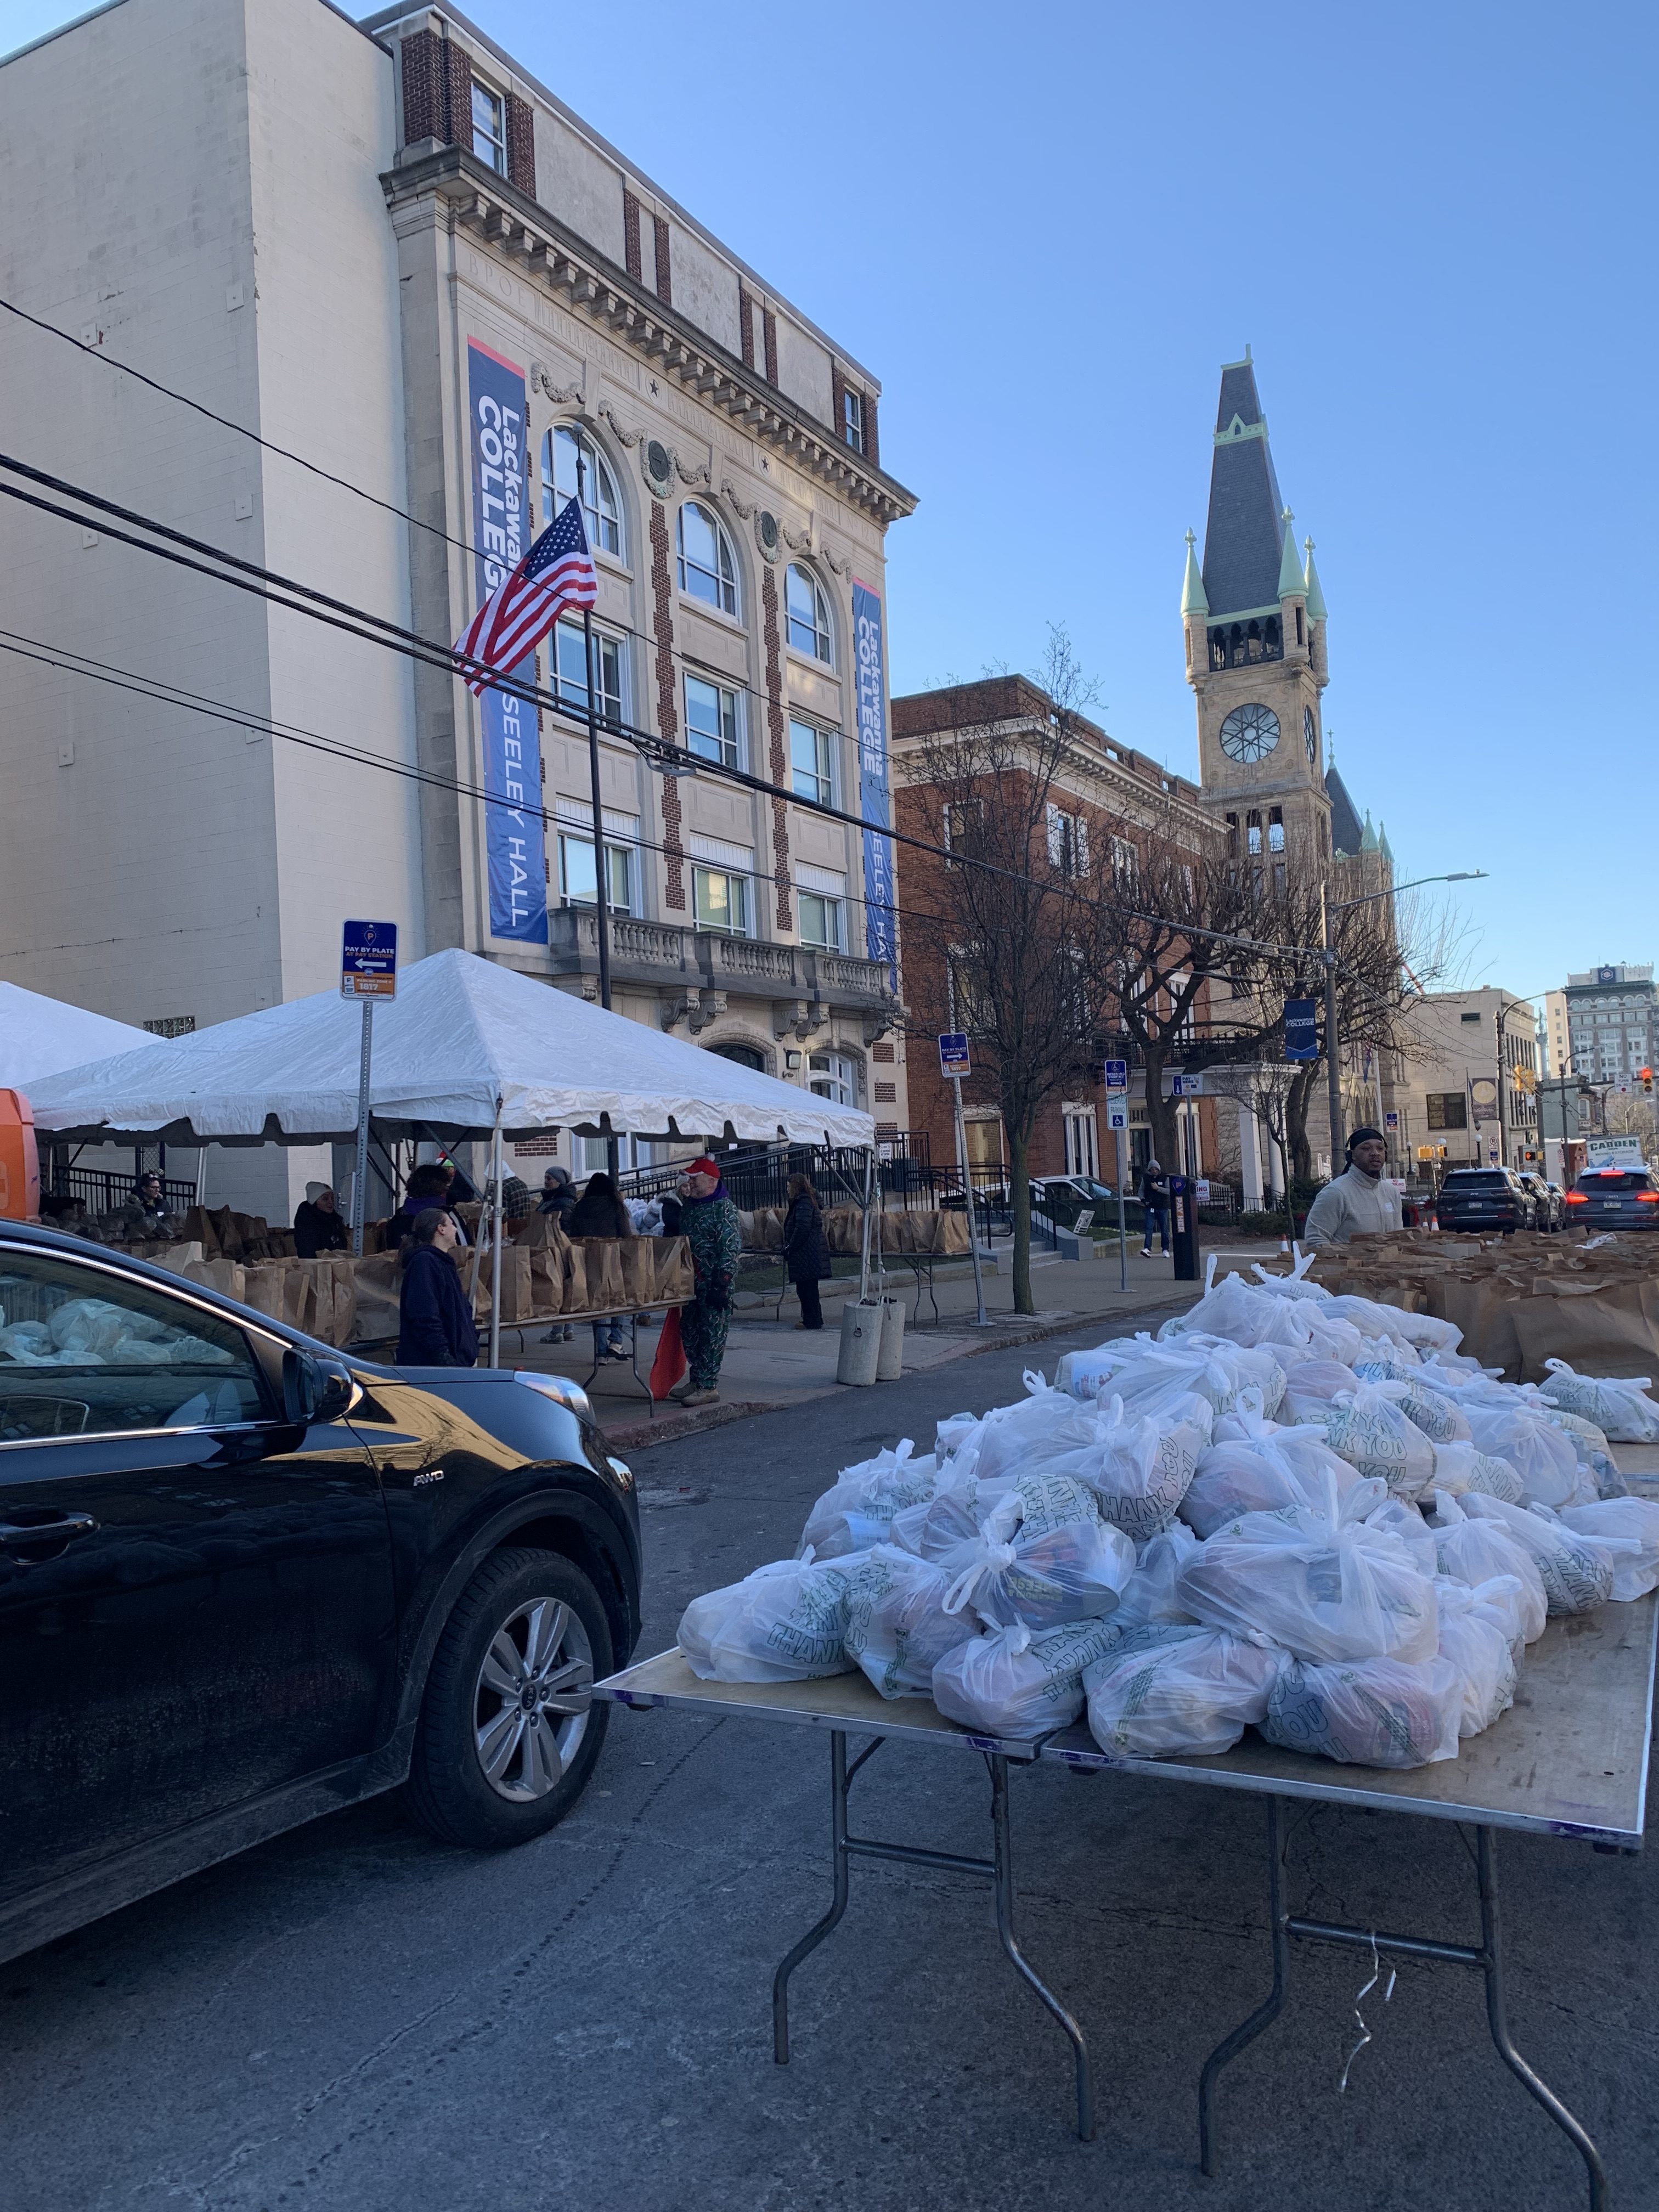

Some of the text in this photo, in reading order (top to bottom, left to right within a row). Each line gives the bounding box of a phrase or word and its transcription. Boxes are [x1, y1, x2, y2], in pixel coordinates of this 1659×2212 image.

[500, 405, 523, 572] Lackawa
[859, 615, 876, 772] COLLEGE
[870, 620, 883, 776] Lackawanna
[501, 692, 528, 927] SEELEY HALL
[877, 921, 887, 962] HA
[1590, 1139, 1637, 1151] CADDEN
[1361, 1434, 1407, 1460] YOU
[413, 1470, 444, 1487] AWD
[526, 1687, 534, 1708] KIA
